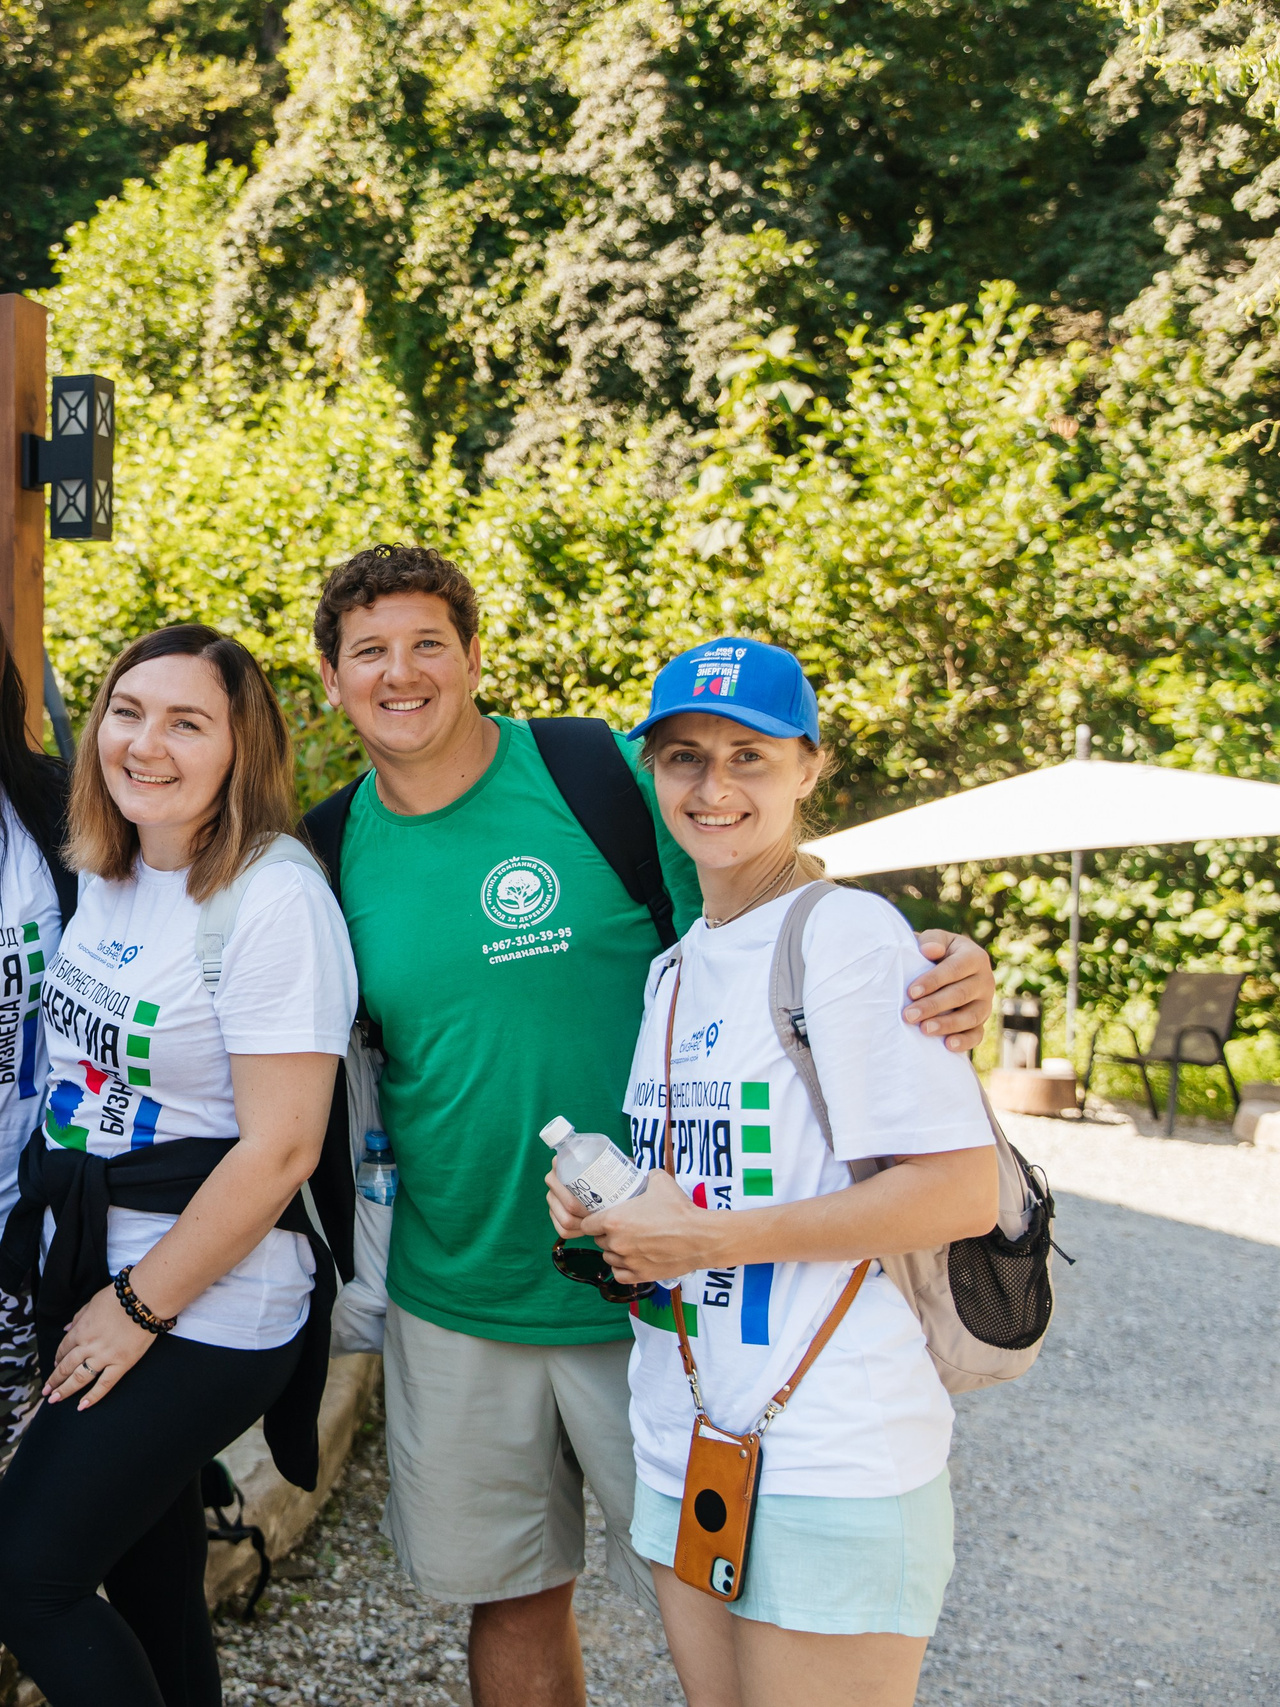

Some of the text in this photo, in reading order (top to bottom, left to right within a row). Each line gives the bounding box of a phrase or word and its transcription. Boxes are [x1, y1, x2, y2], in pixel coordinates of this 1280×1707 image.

[696, 667, 734, 677] ЭНЕРГИЯ
[486, 861, 554, 901] ГРУППА КОМПАНИЙ ФЛОРА
[490, 905, 506, 921] УХОД
[518, 894, 552, 923] ДЕРЕВЬЯМИ
[482, 927, 572, 954] 8-967-310-39-95
[489, 940, 569, 965] спиланапа.рф
[56, 958, 97, 996] БИЗНЕС
[88, 981, 131, 1020] ПОХОД
[40, 980, 120, 1069] НЕРГИЯ
[691, 1081, 732, 1110] ПОХОД
